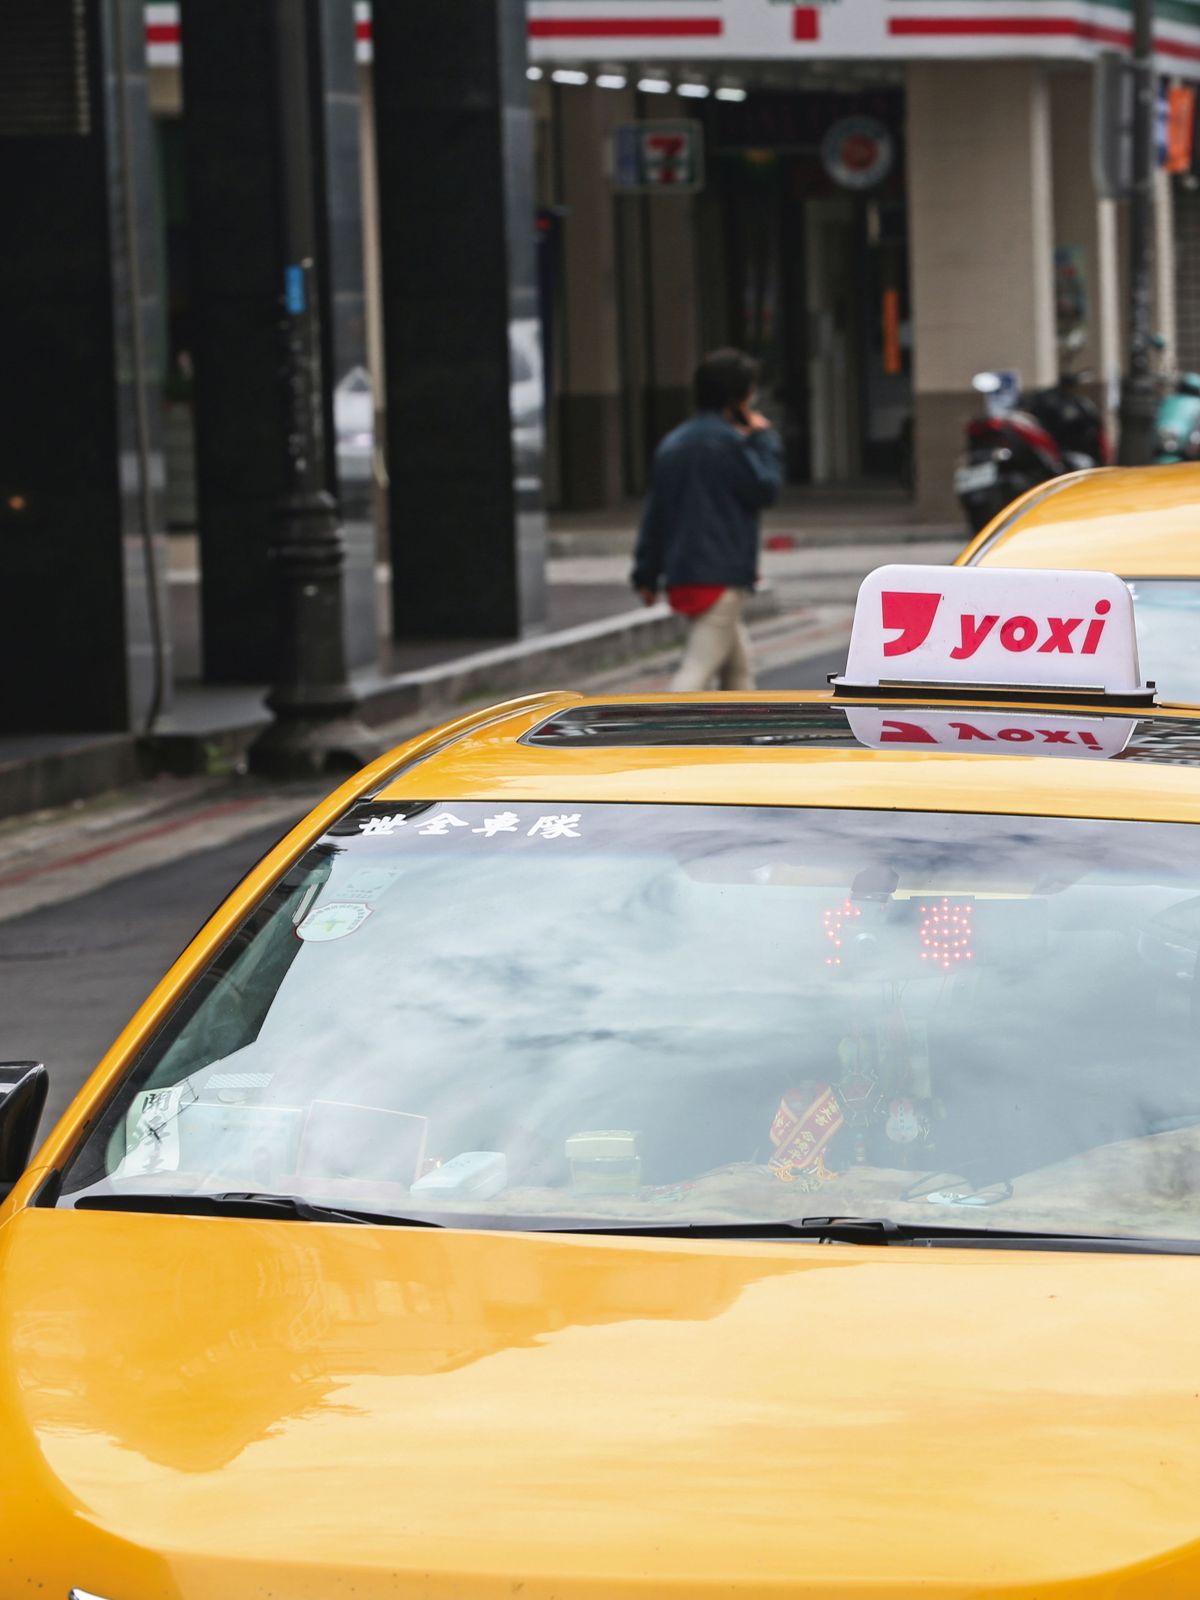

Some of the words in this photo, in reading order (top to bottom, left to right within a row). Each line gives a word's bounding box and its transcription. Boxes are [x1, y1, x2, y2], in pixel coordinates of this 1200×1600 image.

[950, 599, 1111, 660] yoxi
[358, 811, 582, 839] 世全車隊
